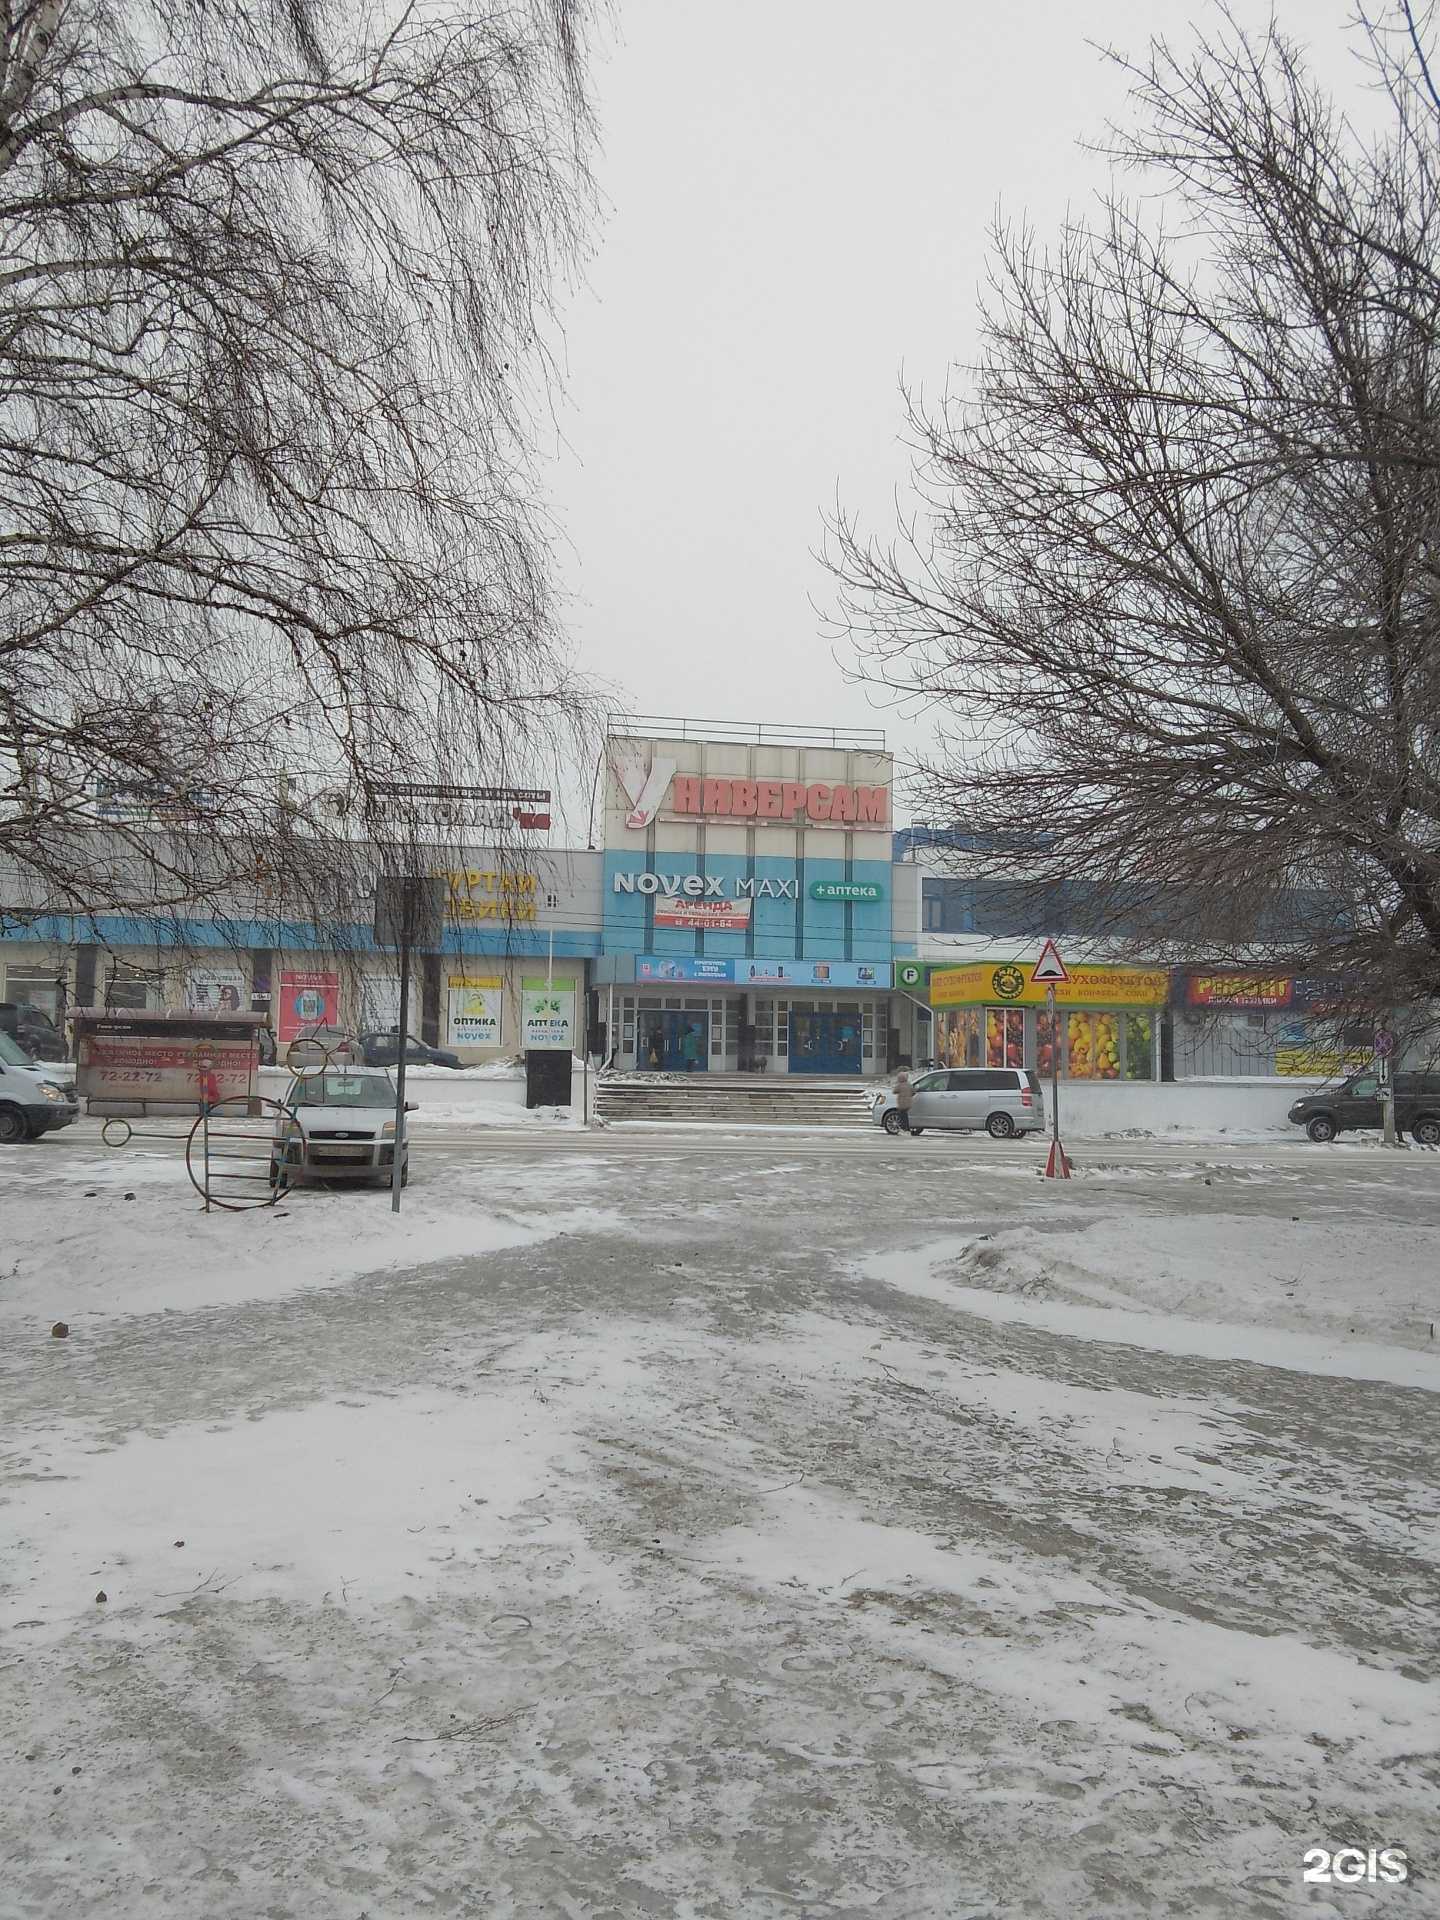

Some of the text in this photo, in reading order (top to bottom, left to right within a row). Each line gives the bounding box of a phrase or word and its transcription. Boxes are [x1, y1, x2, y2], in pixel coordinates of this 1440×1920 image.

[735, 876, 799, 899] MAXI
[454, 1017, 497, 1026] ОПТИКА
[528, 1019, 569, 1028] АПТЕКА
